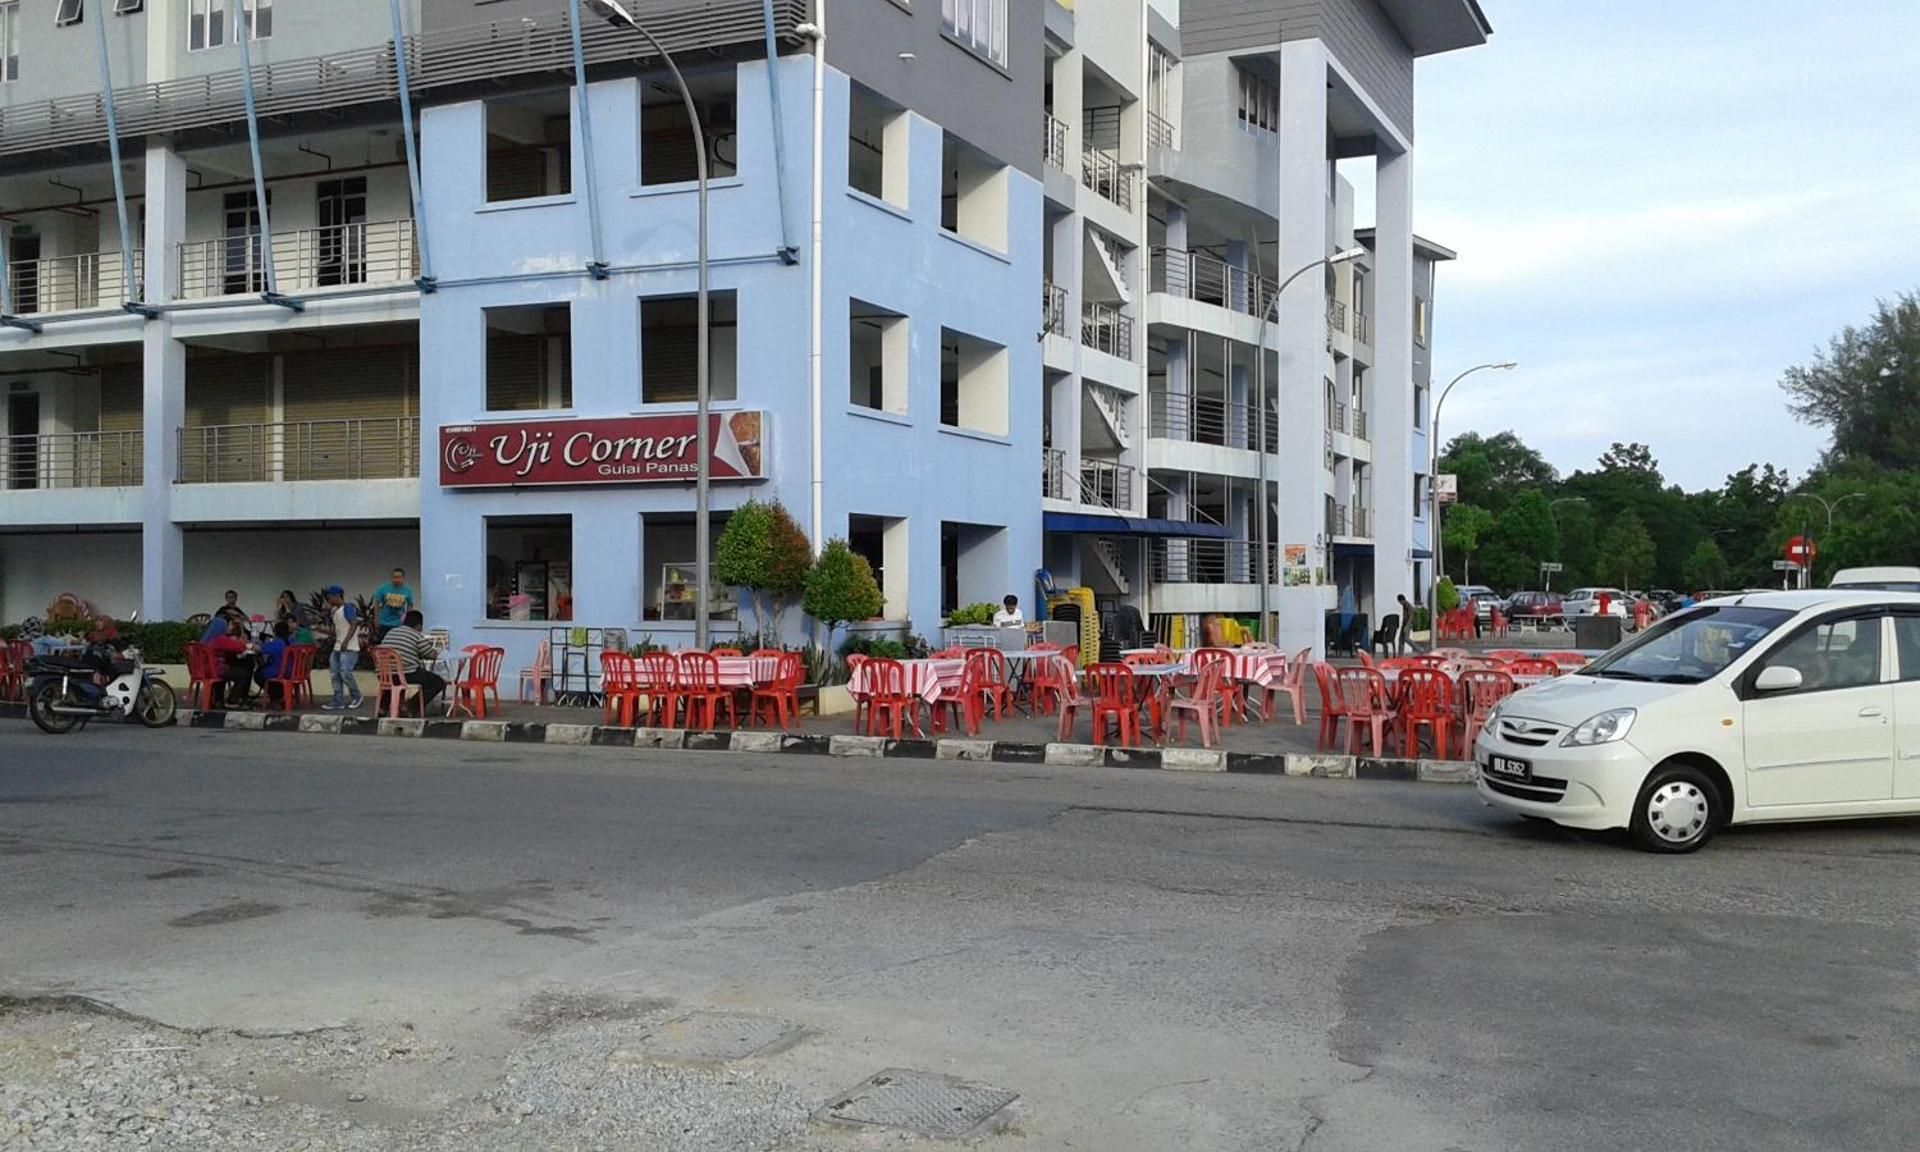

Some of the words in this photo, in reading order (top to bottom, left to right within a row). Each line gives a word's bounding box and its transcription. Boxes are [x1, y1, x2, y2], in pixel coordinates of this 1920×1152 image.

[489, 429, 552, 476] Uji
[563, 431, 698, 467] Corner
[597, 463, 640, 475] Gulai
[646, 462, 699, 474] Panas
